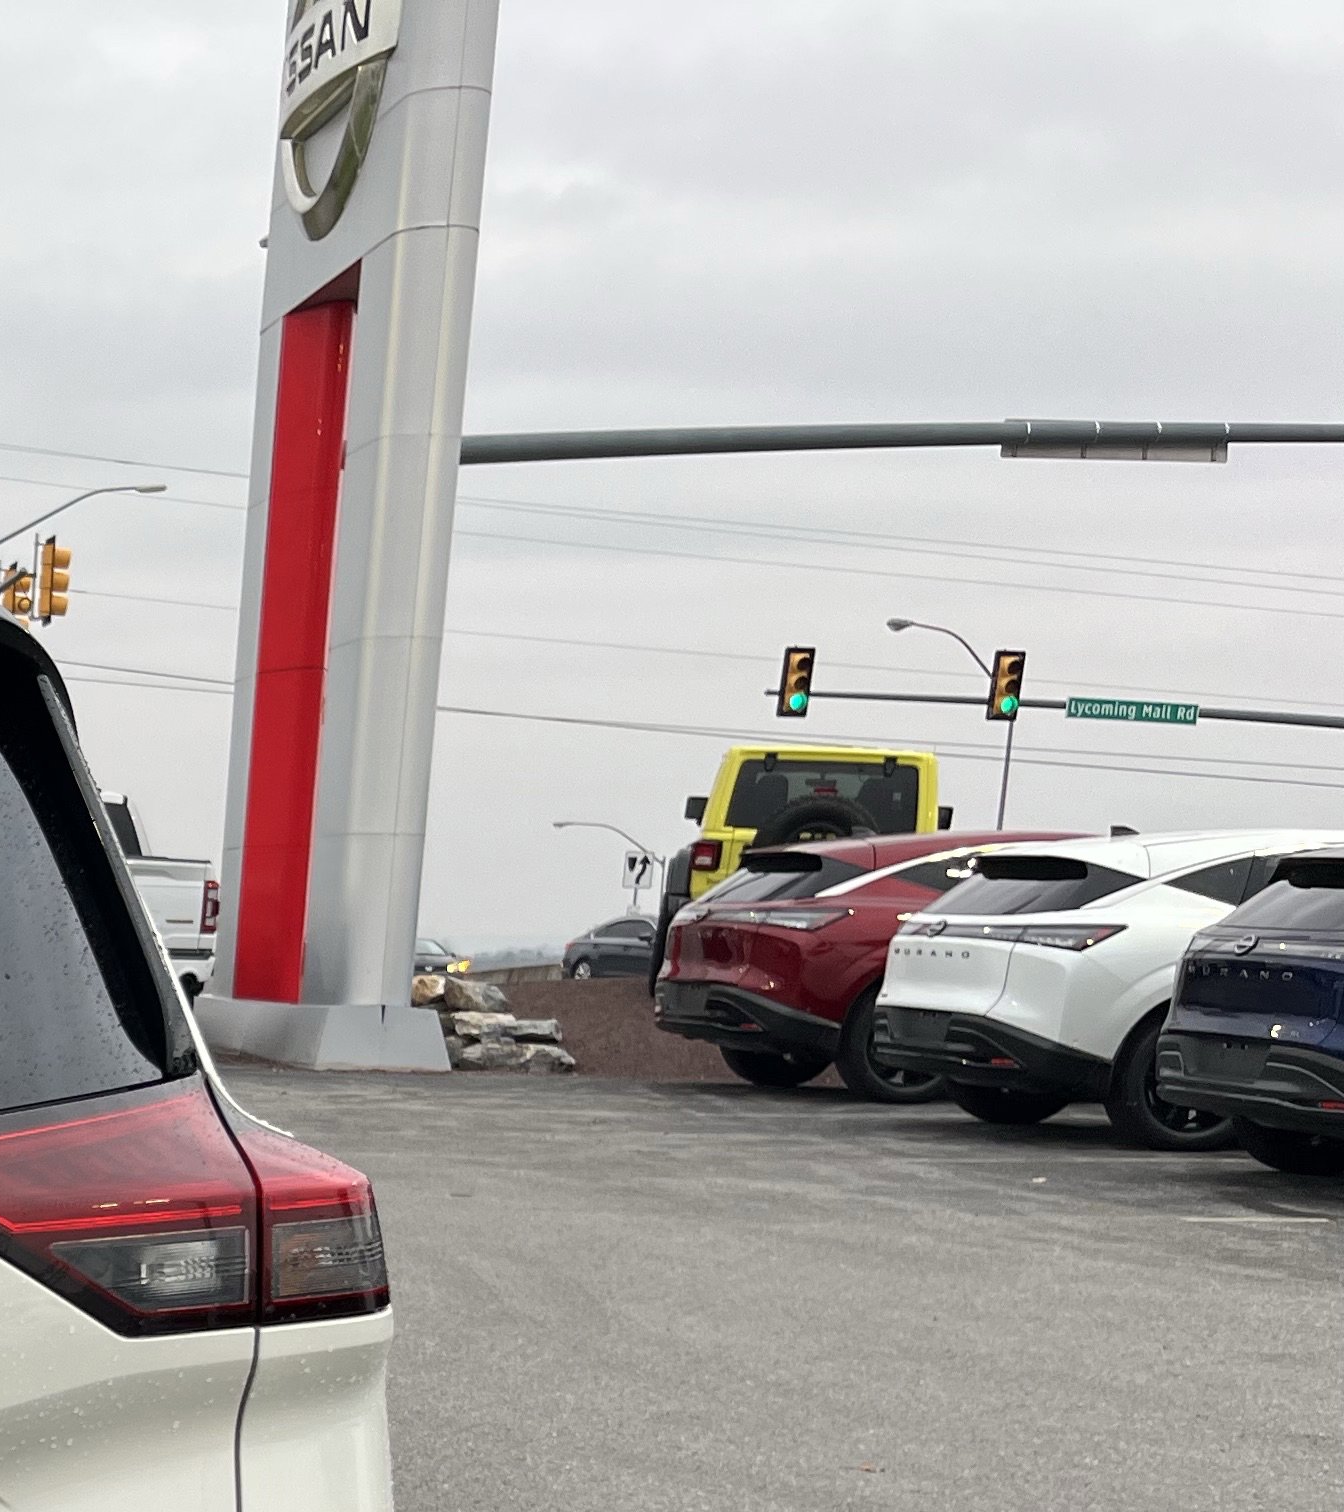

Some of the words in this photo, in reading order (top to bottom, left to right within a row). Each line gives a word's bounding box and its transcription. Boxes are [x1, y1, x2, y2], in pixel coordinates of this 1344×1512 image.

[1071, 700, 1136, 720] Lycoming
[1142, 704, 1171, 719] Mall
[1177, 706, 1195, 720] Rd
